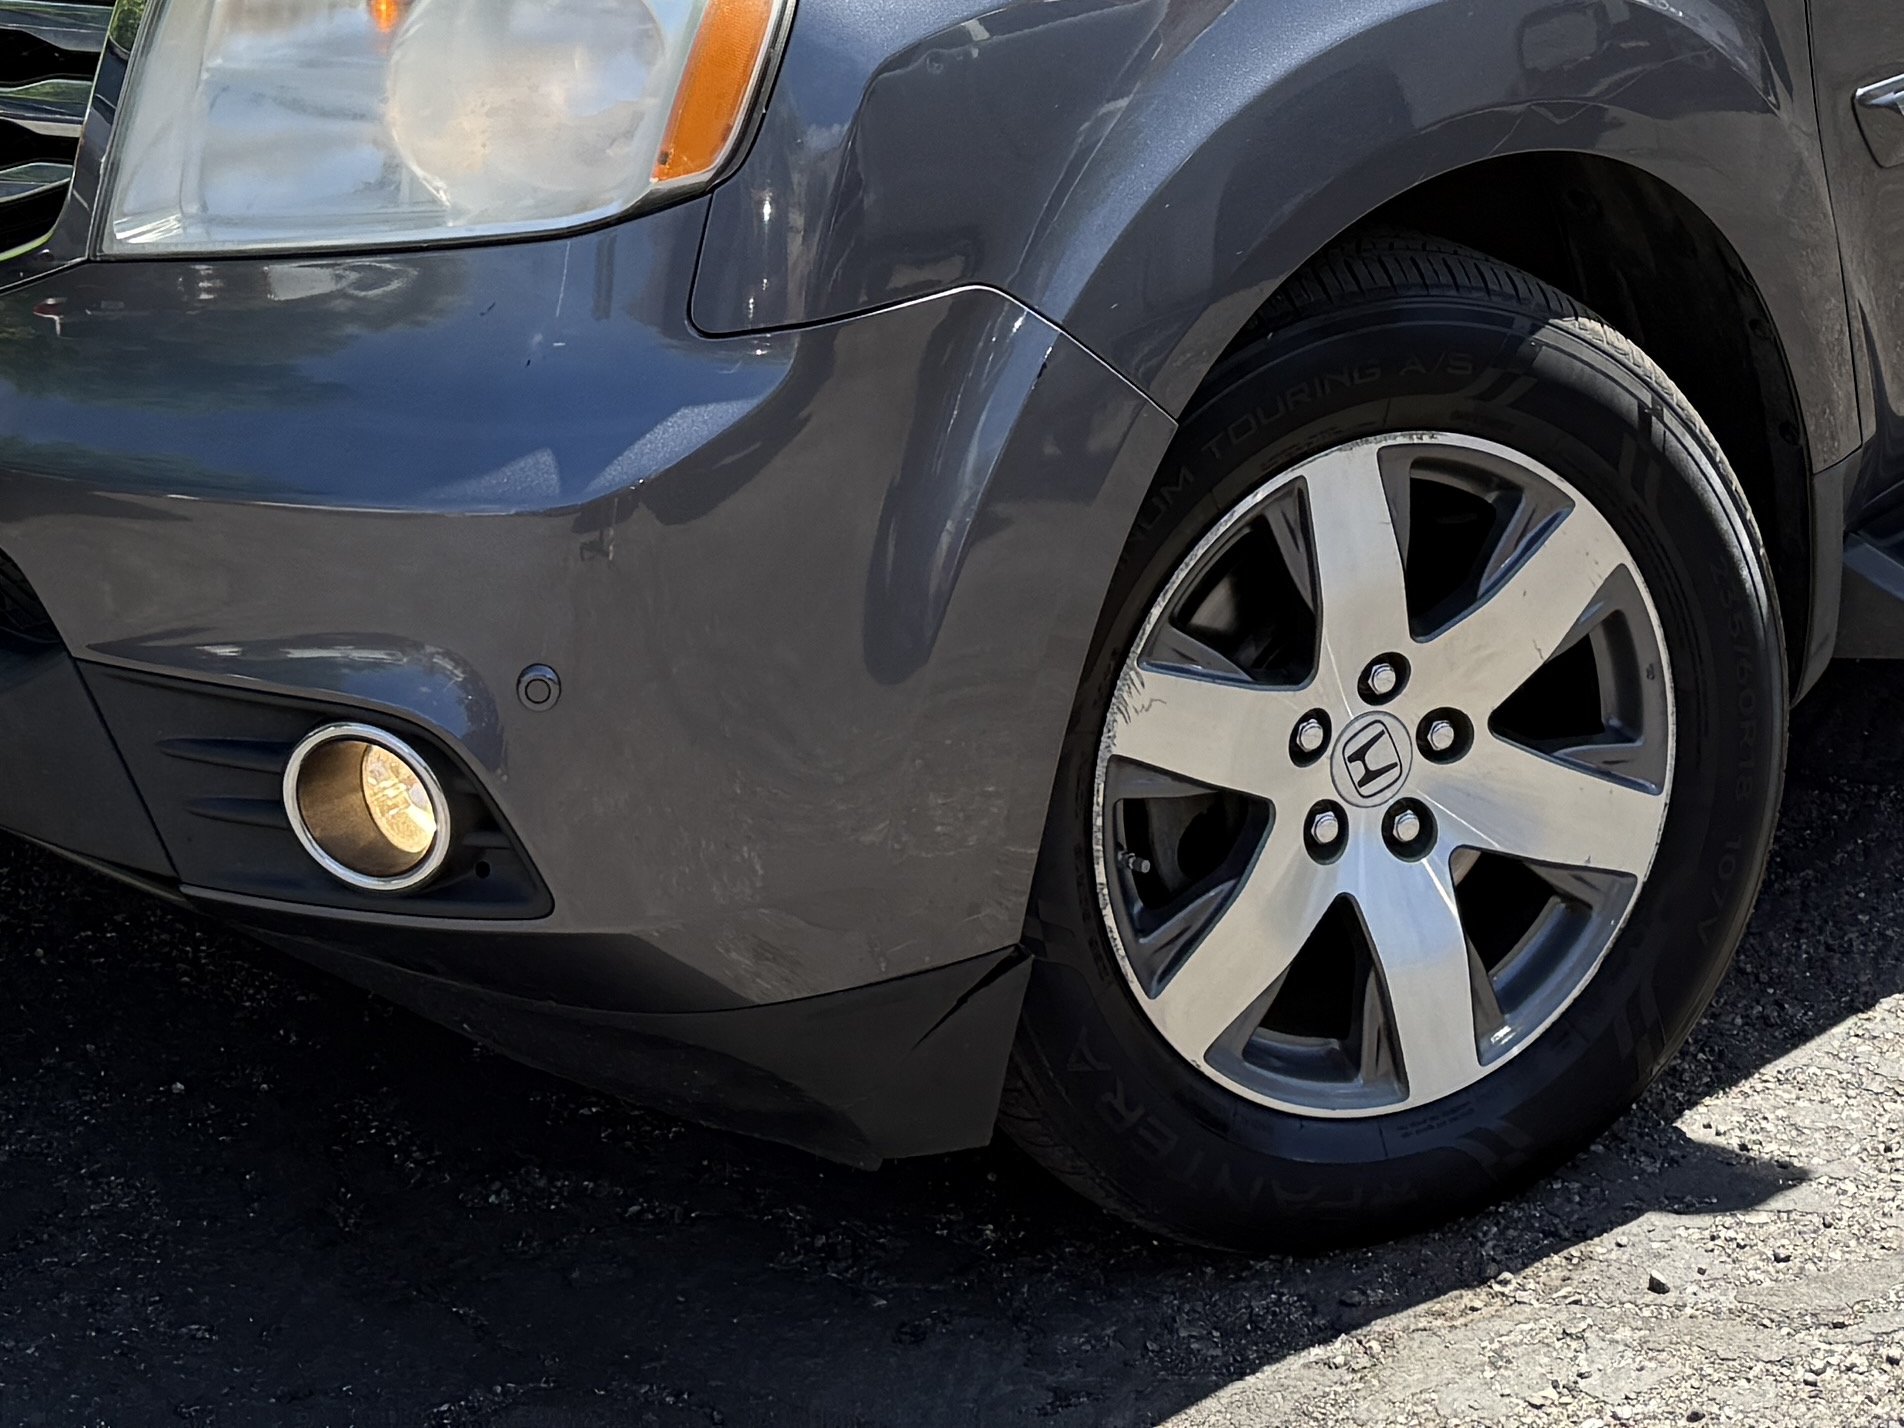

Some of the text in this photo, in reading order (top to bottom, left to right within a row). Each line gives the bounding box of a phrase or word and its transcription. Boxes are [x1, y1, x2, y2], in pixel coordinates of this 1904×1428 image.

[1201, 358, 1382, 460] TOURING
[1398, 351, 1473, 377] A/S
[1697, 833, 1743, 946] 107V
